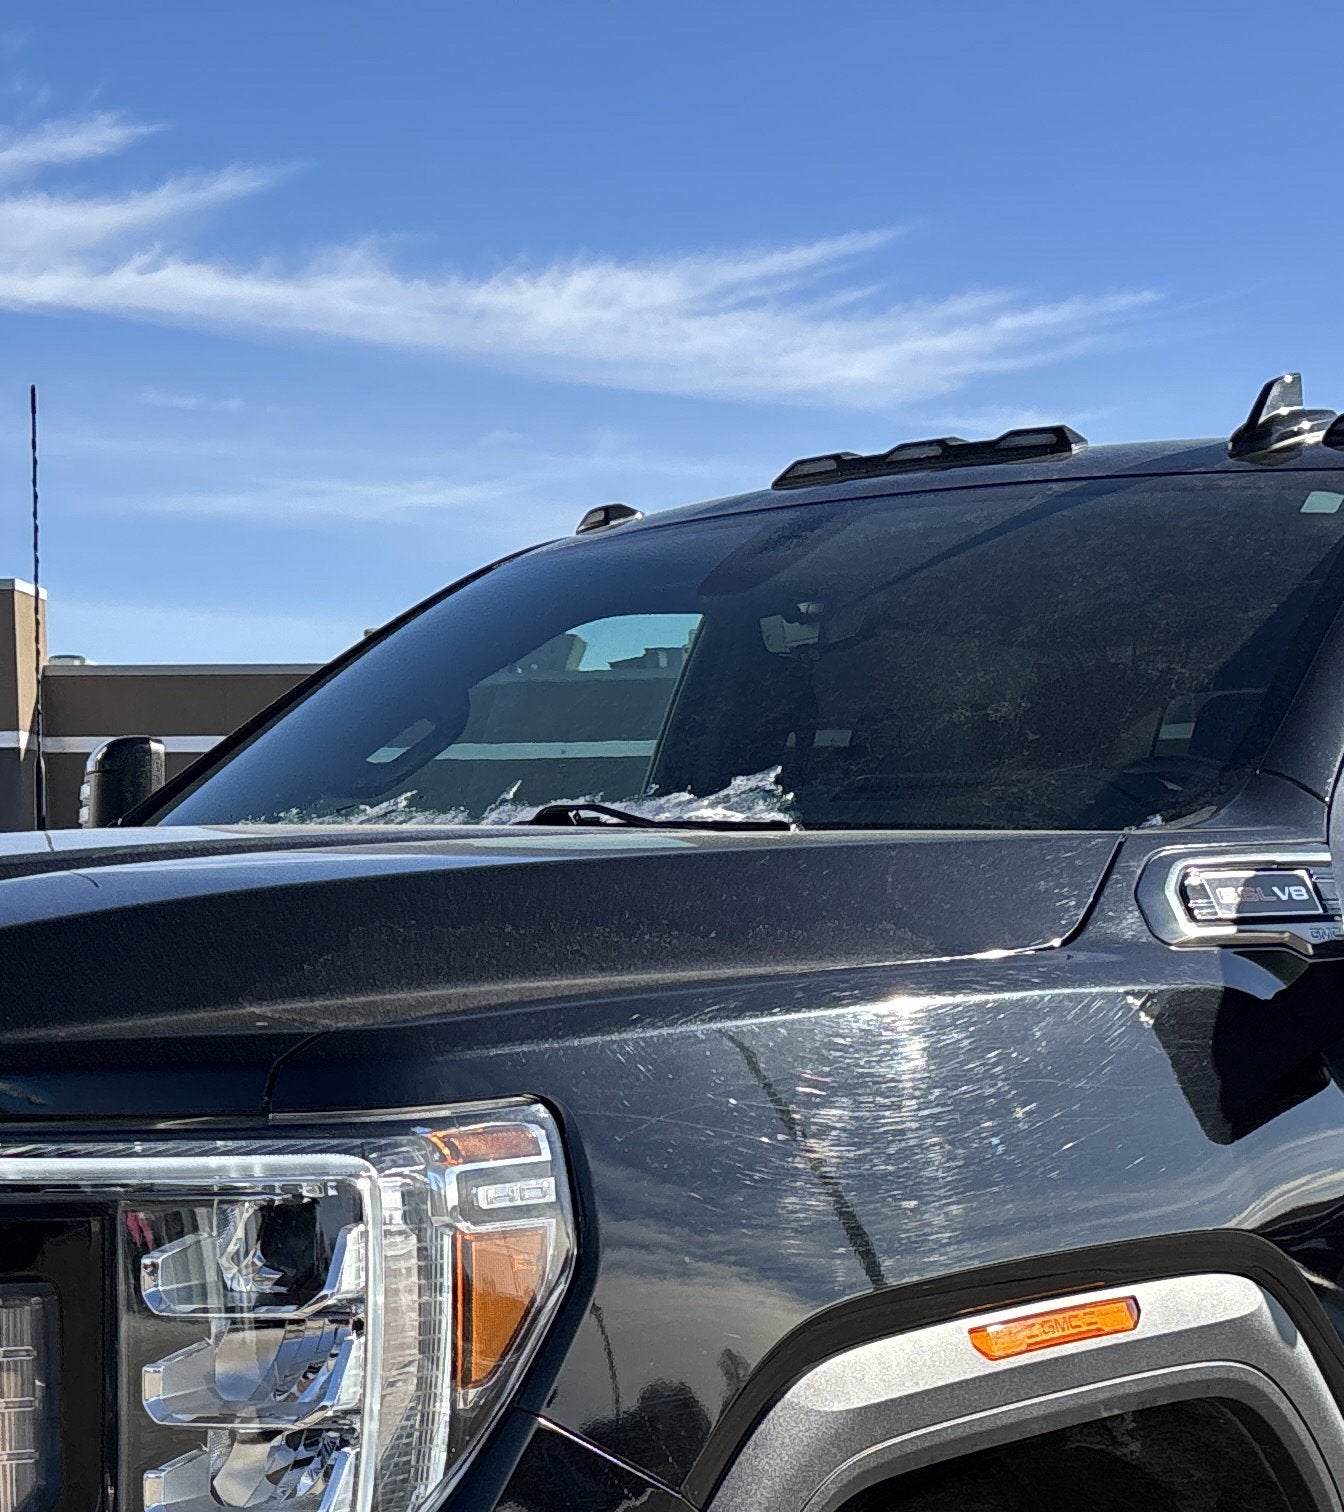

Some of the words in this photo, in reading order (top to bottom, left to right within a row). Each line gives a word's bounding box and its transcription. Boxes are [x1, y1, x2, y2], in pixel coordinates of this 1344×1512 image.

[1272, 886, 1309, 900] V8
[1309, 927, 1344, 940] GMC
[1041, 1313, 1082, 1335] GMC
